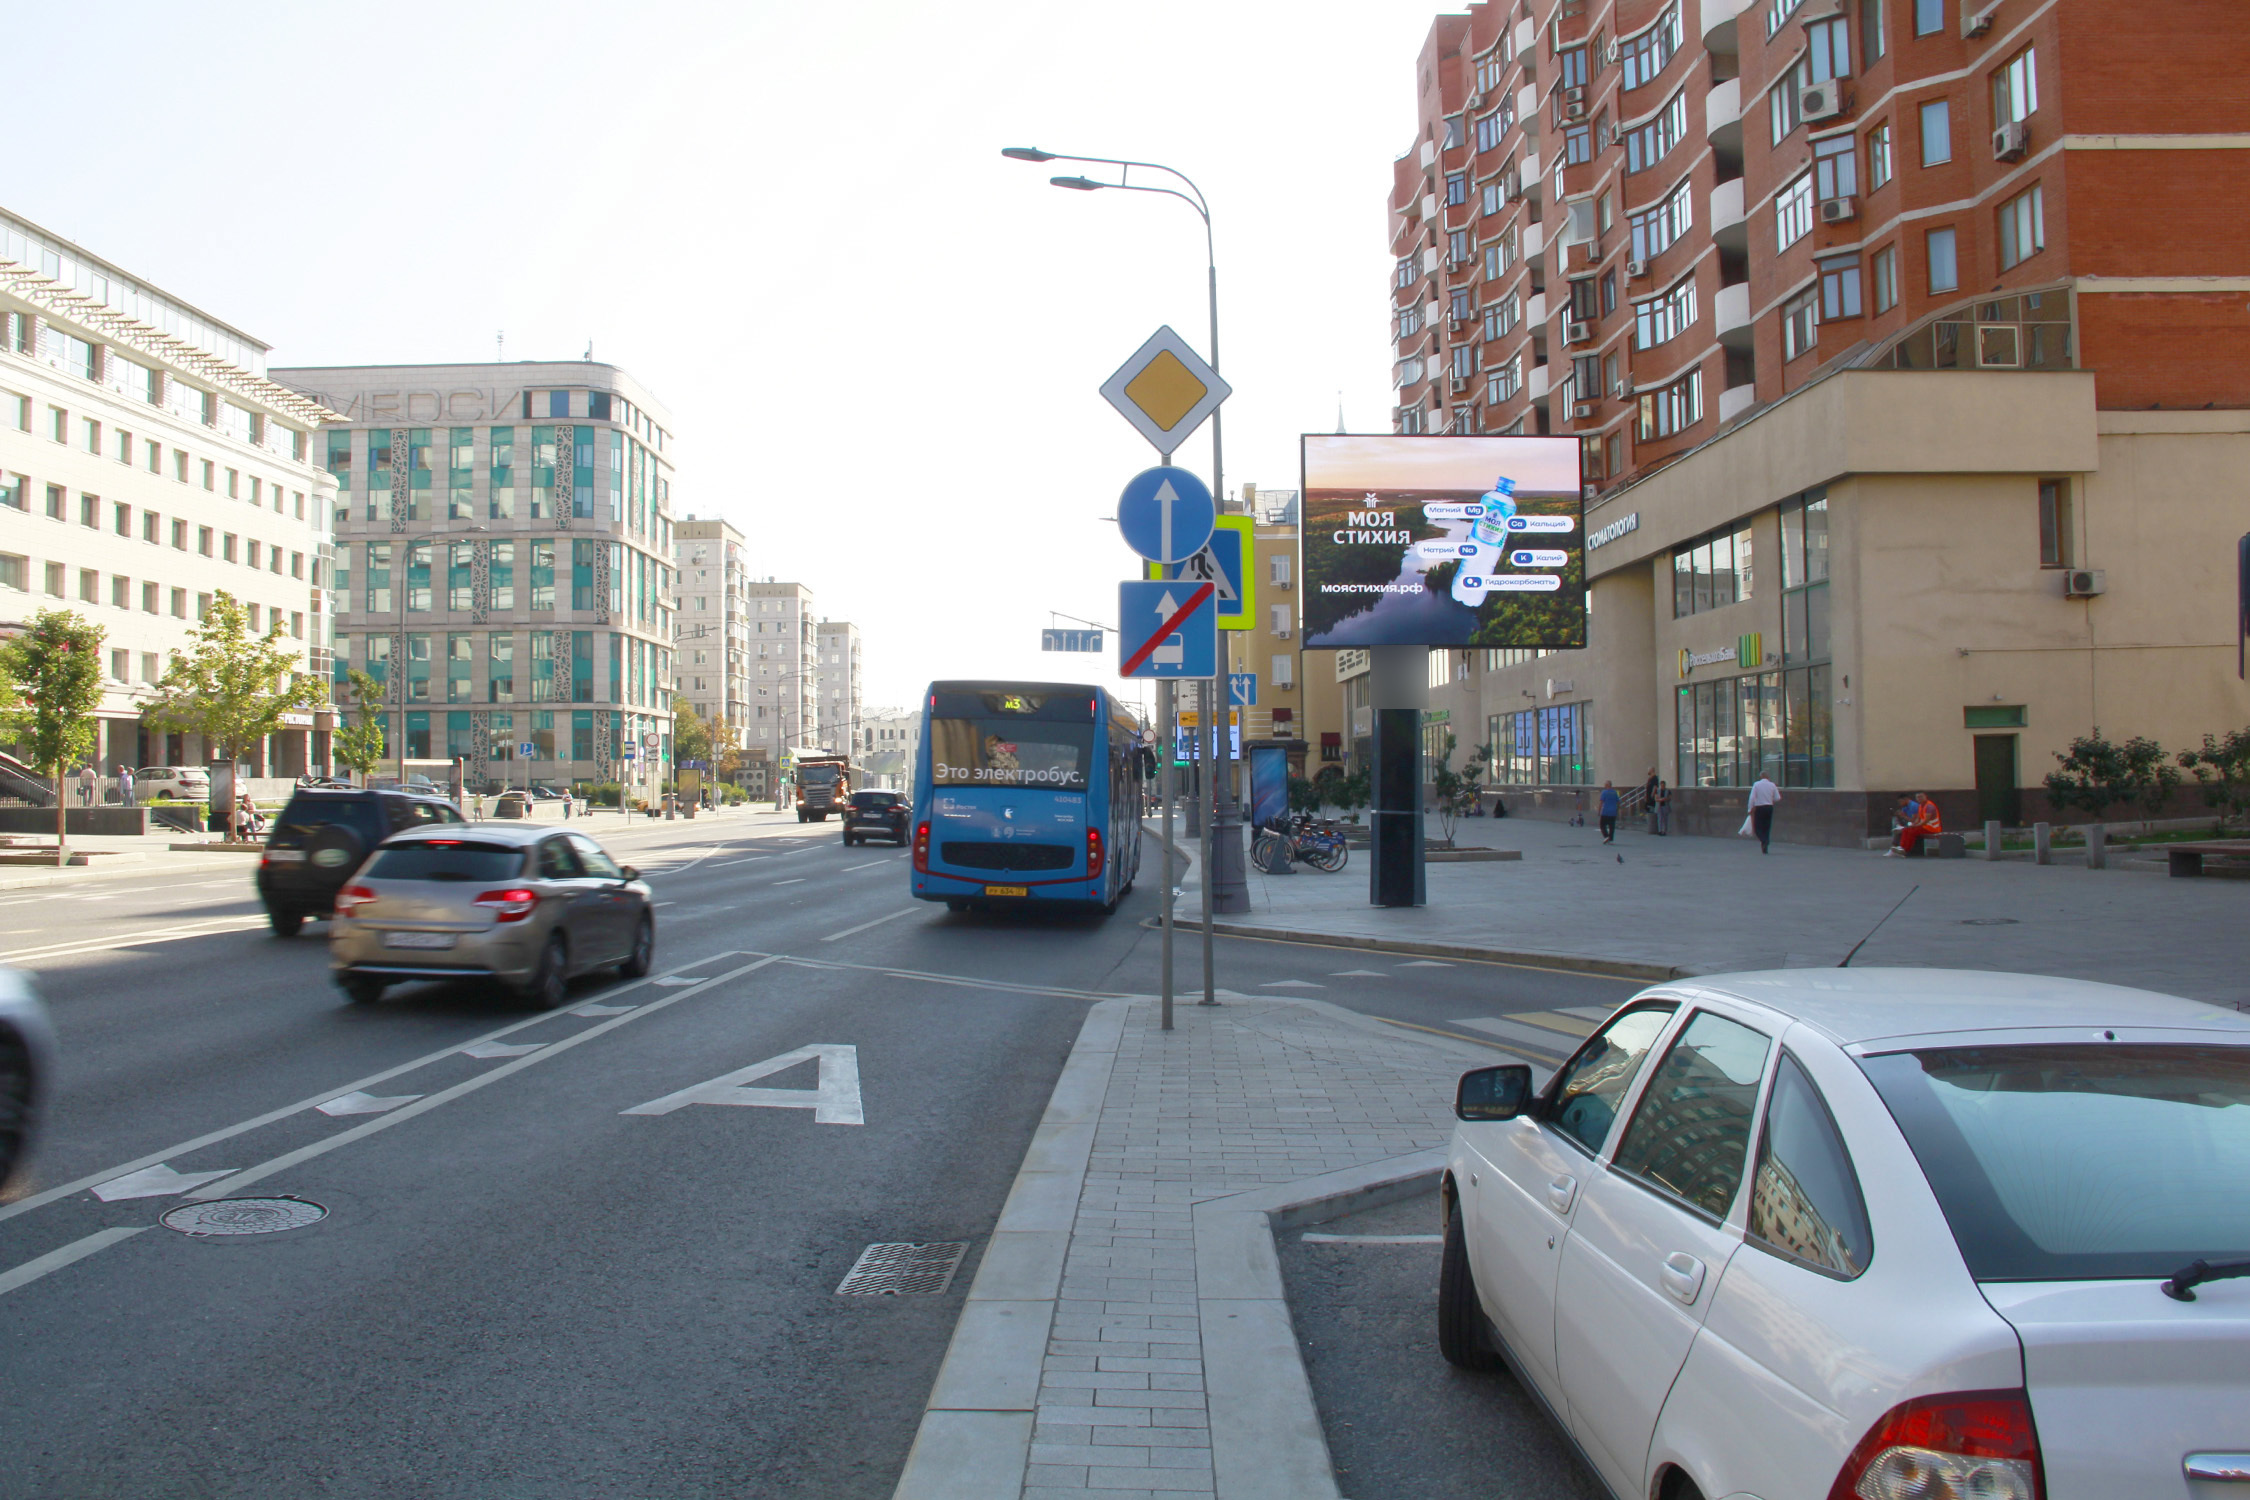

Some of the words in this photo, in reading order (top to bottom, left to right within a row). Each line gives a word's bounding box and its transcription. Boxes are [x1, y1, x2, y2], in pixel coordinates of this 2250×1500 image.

[1429, 506, 1461, 514] Магний
[1467, 507, 1481, 515] Mg
[1348, 512, 1395, 527] МОЯ
[1485, 516, 1501, 526] МОЯ
[1511, 520, 1523, 528] Ca
[1530, 520, 1566, 528] Кальций
[1333, 529, 1411, 545] СТИХИЯ
[1587, 513, 1636, 551] СТОМАТОЛОГИЯ
[1423, 546, 1455, 554] Натрий
[1485, 577, 1556, 586] Гидрокарбонаты
[1321, 582, 1423, 595] моястихия.рф
[935, 763, 969, 779] Это
[973, 766, 1085, 786] электробус.
